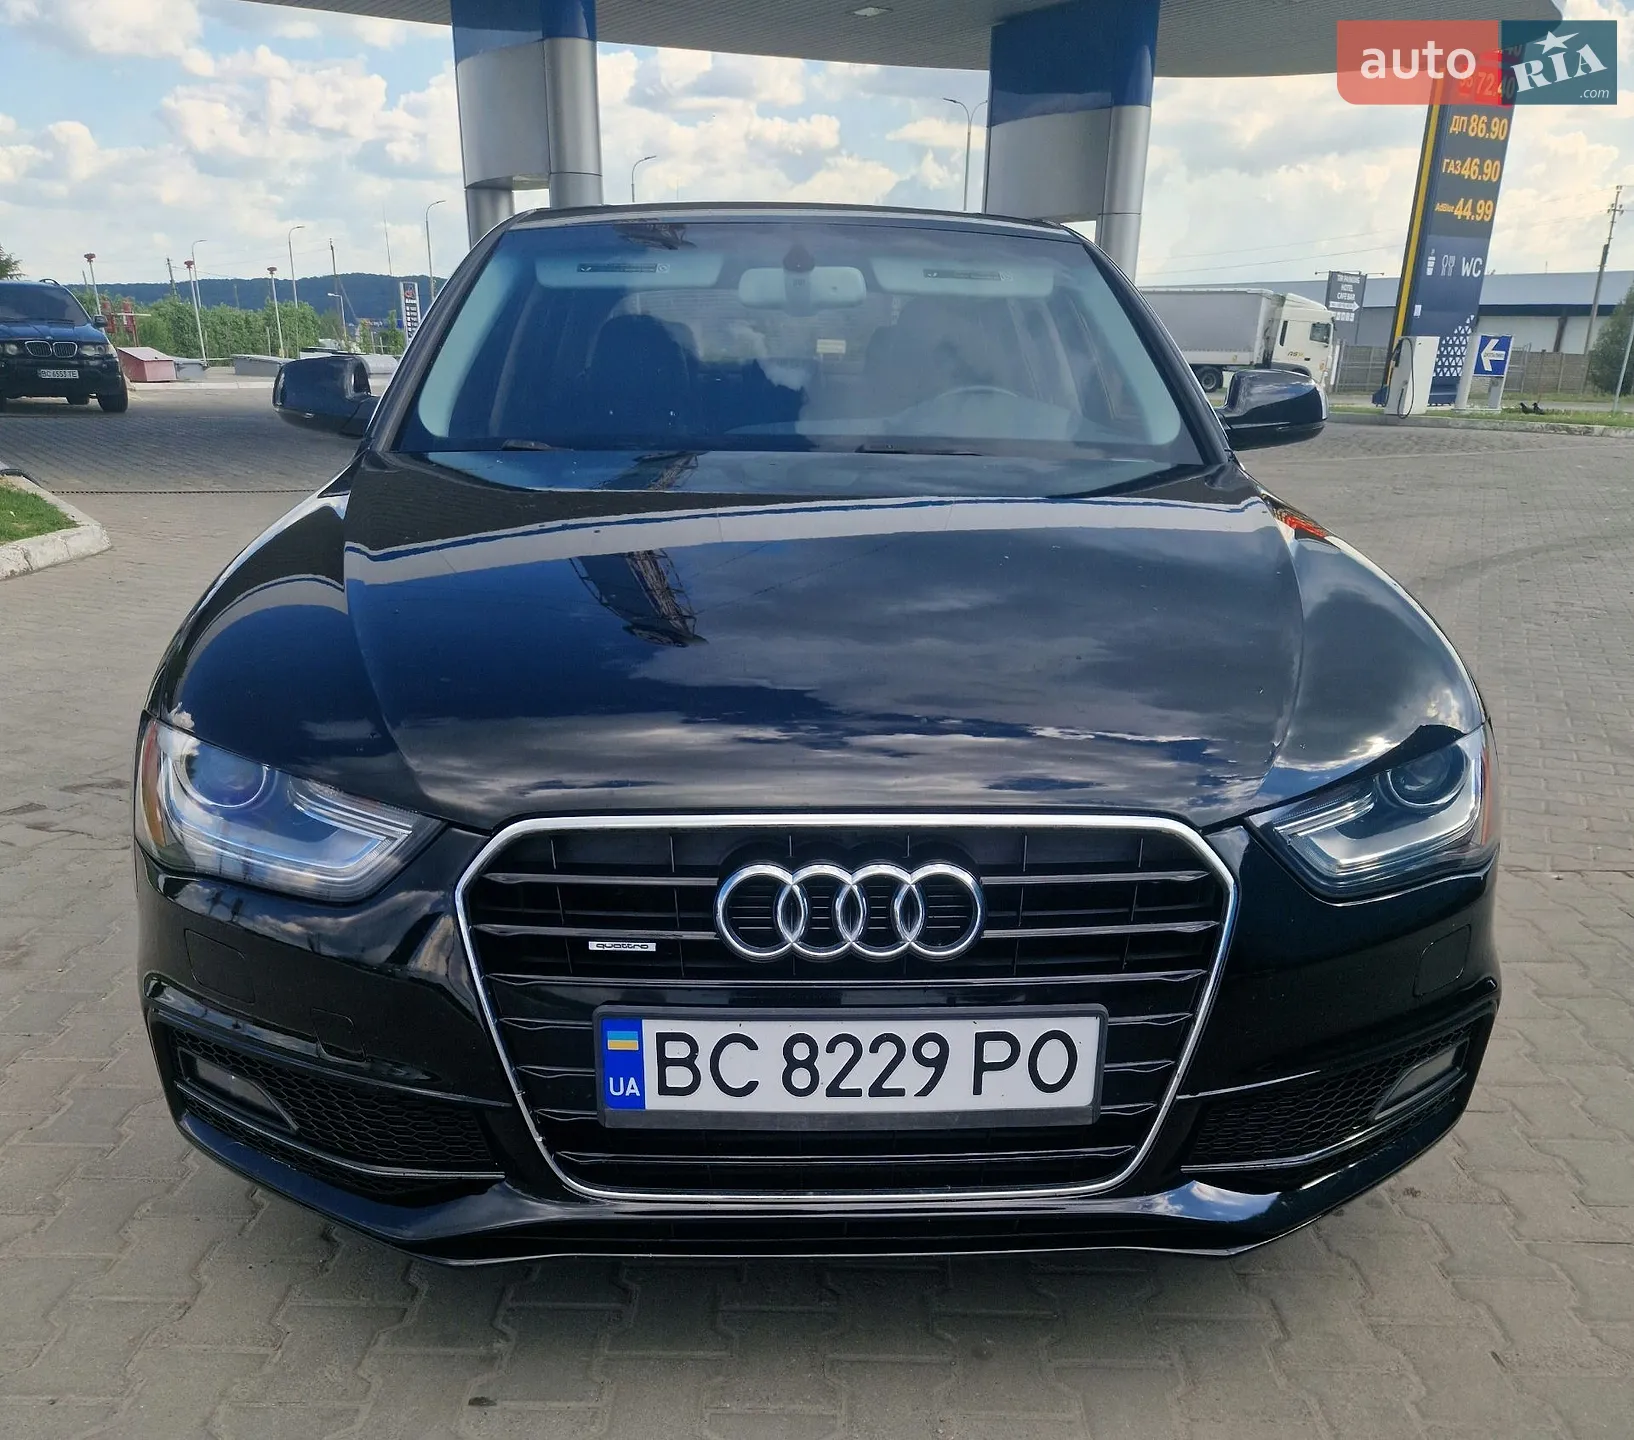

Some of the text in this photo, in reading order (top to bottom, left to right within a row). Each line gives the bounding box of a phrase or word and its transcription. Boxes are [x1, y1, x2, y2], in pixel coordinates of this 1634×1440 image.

[1449, 114, 1509, 141] ДП 86.90
[1442, 157, 1501, 182] ГАЗ 46.90
[1454, 198, 1494, 221] 44.99
[1461, 256, 1483, 278] WC
[656, 1029, 1078, 1098] BC 8229 PO
[609, 1076, 641, 1097] UA
